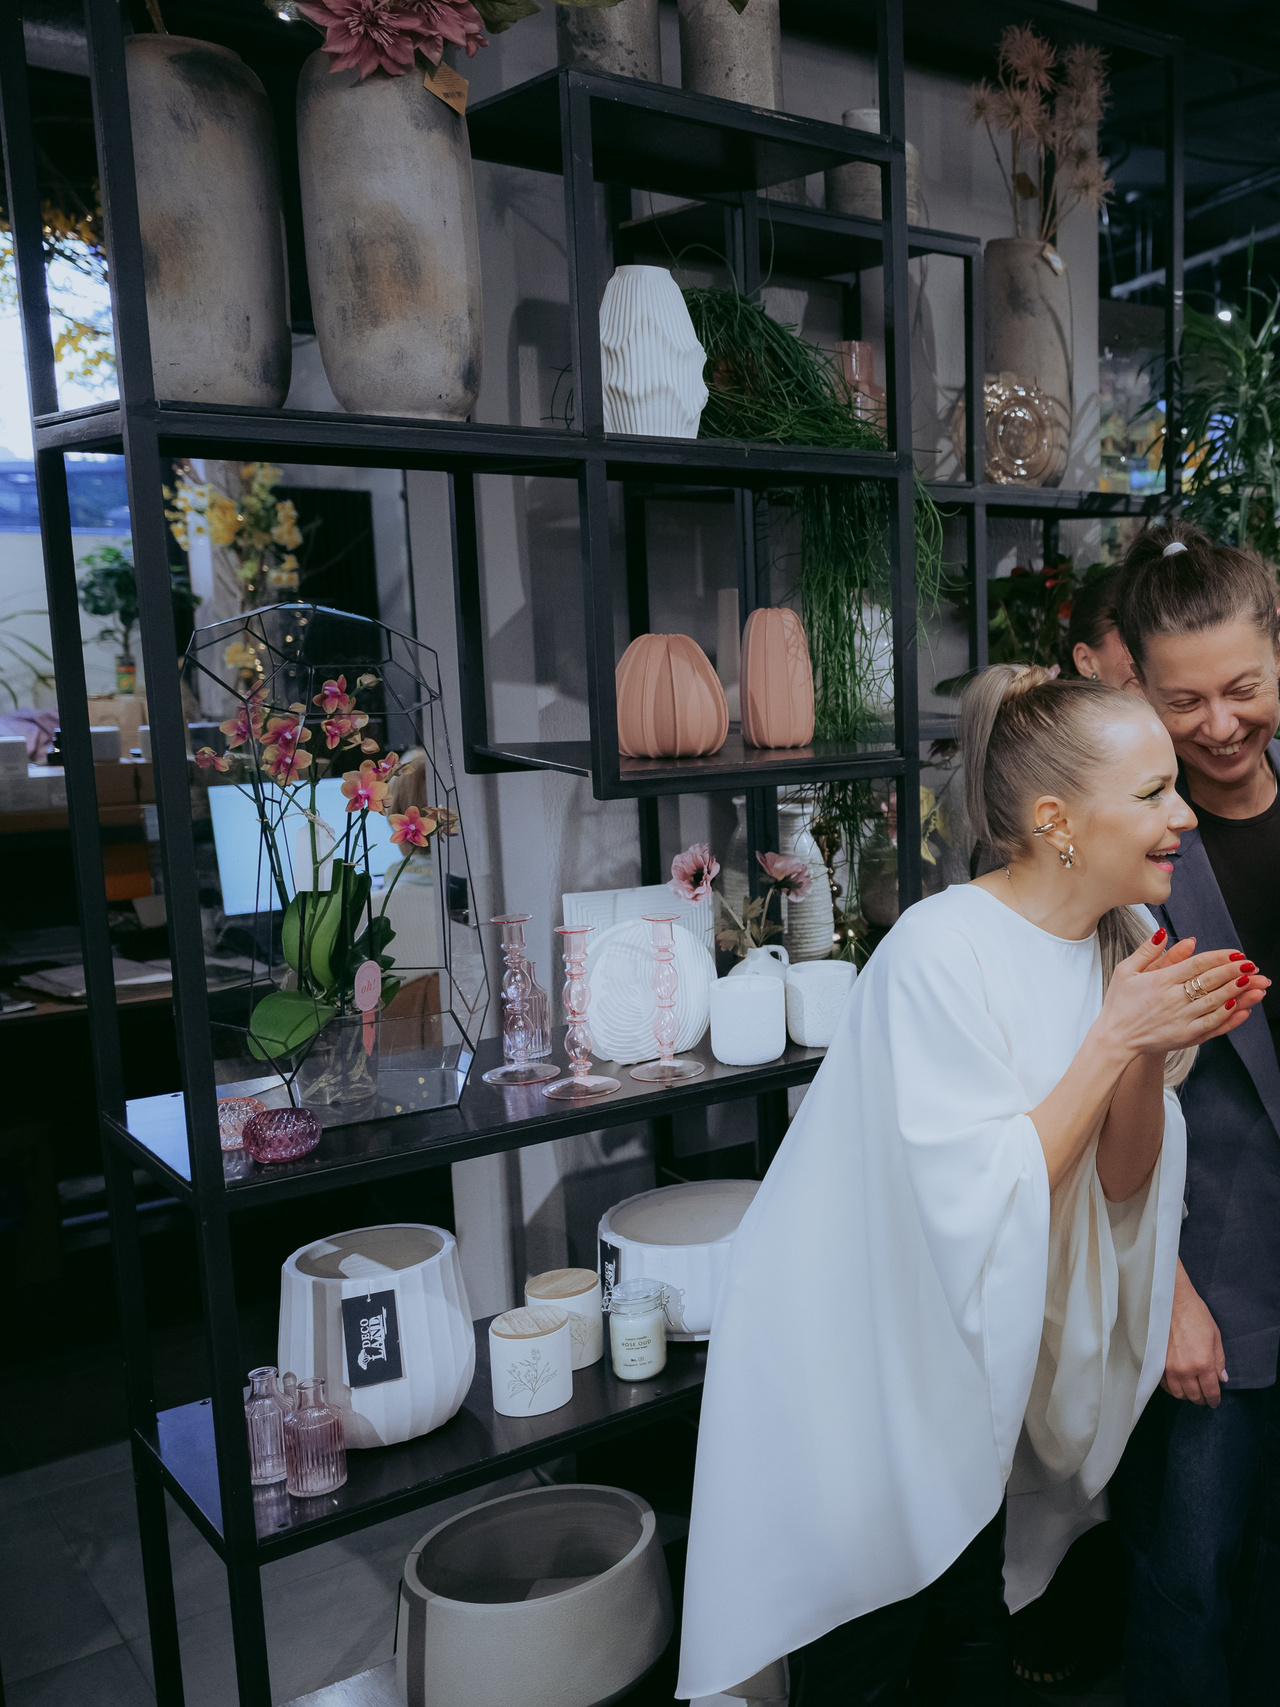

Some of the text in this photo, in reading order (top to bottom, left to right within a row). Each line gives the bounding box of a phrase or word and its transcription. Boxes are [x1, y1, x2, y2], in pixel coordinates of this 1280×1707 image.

[360, 1318, 371, 1348] DECO
[369, 1314, 384, 1361] LAND
[638, 1338, 652, 1347] OUD
